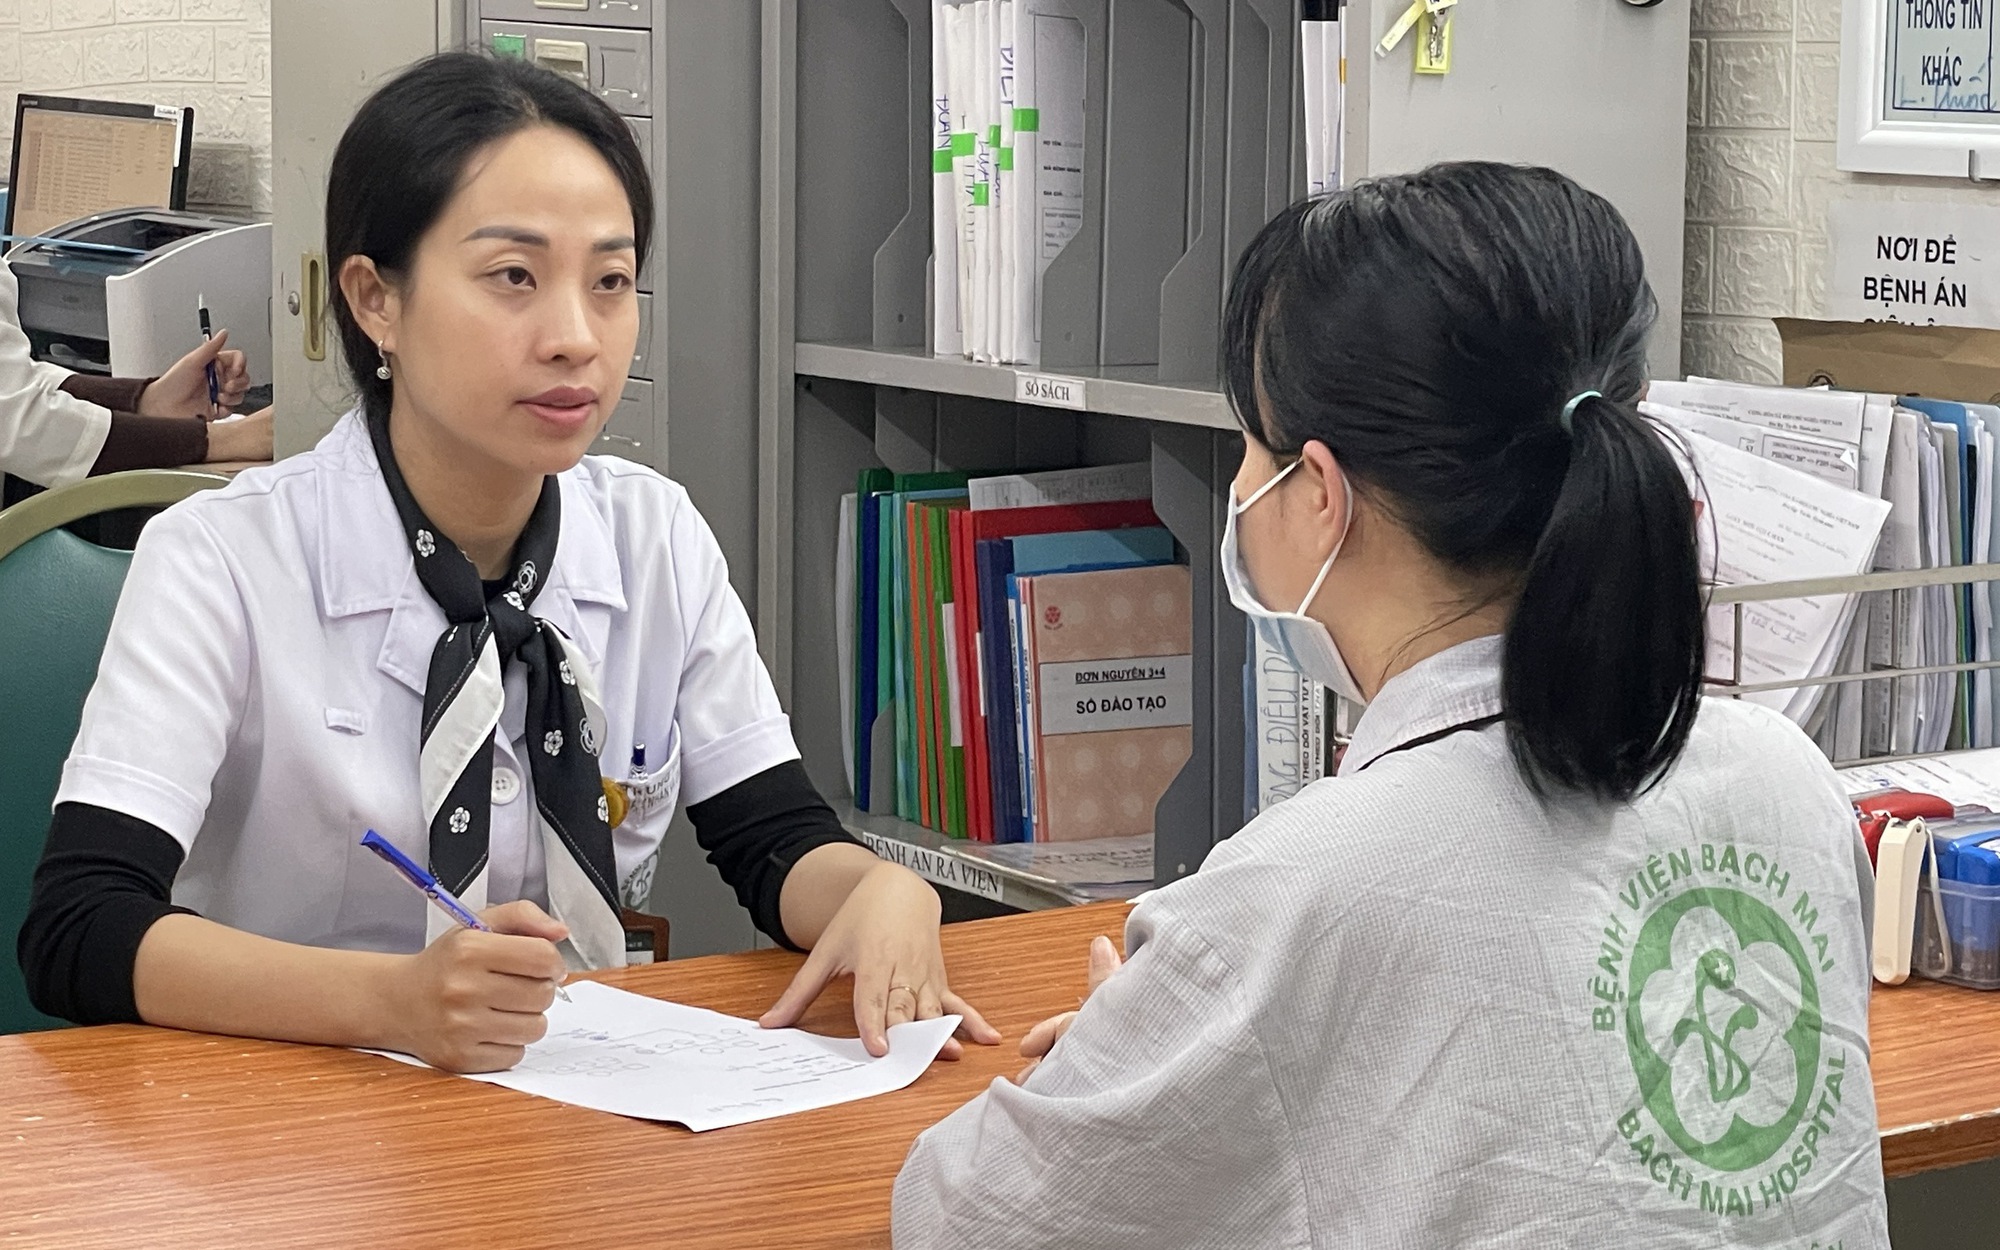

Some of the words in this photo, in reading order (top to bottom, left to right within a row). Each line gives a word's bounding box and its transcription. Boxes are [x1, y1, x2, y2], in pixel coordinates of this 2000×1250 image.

[1961, 0, 1983, 29] TIN
[1921, 46, 1962, 87] KHÁC
[1877, 235, 1918, 262] NƠI
[1925, 233, 1957, 265] ĐỂ
[1863, 273, 1926, 308] BỆNH
[1933, 276, 1967, 308] ÁN
[1041, 380, 1070, 401] SÁCH
[1075, 670, 1099, 683] ĐƠN
[1102, 666, 1146, 681] NGUYÊN
[1137, 695, 1167, 713] TẠO
[936, 855, 957, 882] RA
[1586, 912, 1628, 1032] BỆNH
[1618, 847, 1692, 911] VIỆN
[1701, 843, 1791, 899] BẠCH
[1792, 889, 1835, 973] MAI
[1617, 1107, 1694, 1201] BACH
[1701, 1179, 1754, 1217] MAI
[1758, 1047, 1846, 1210] HOSPITAL
